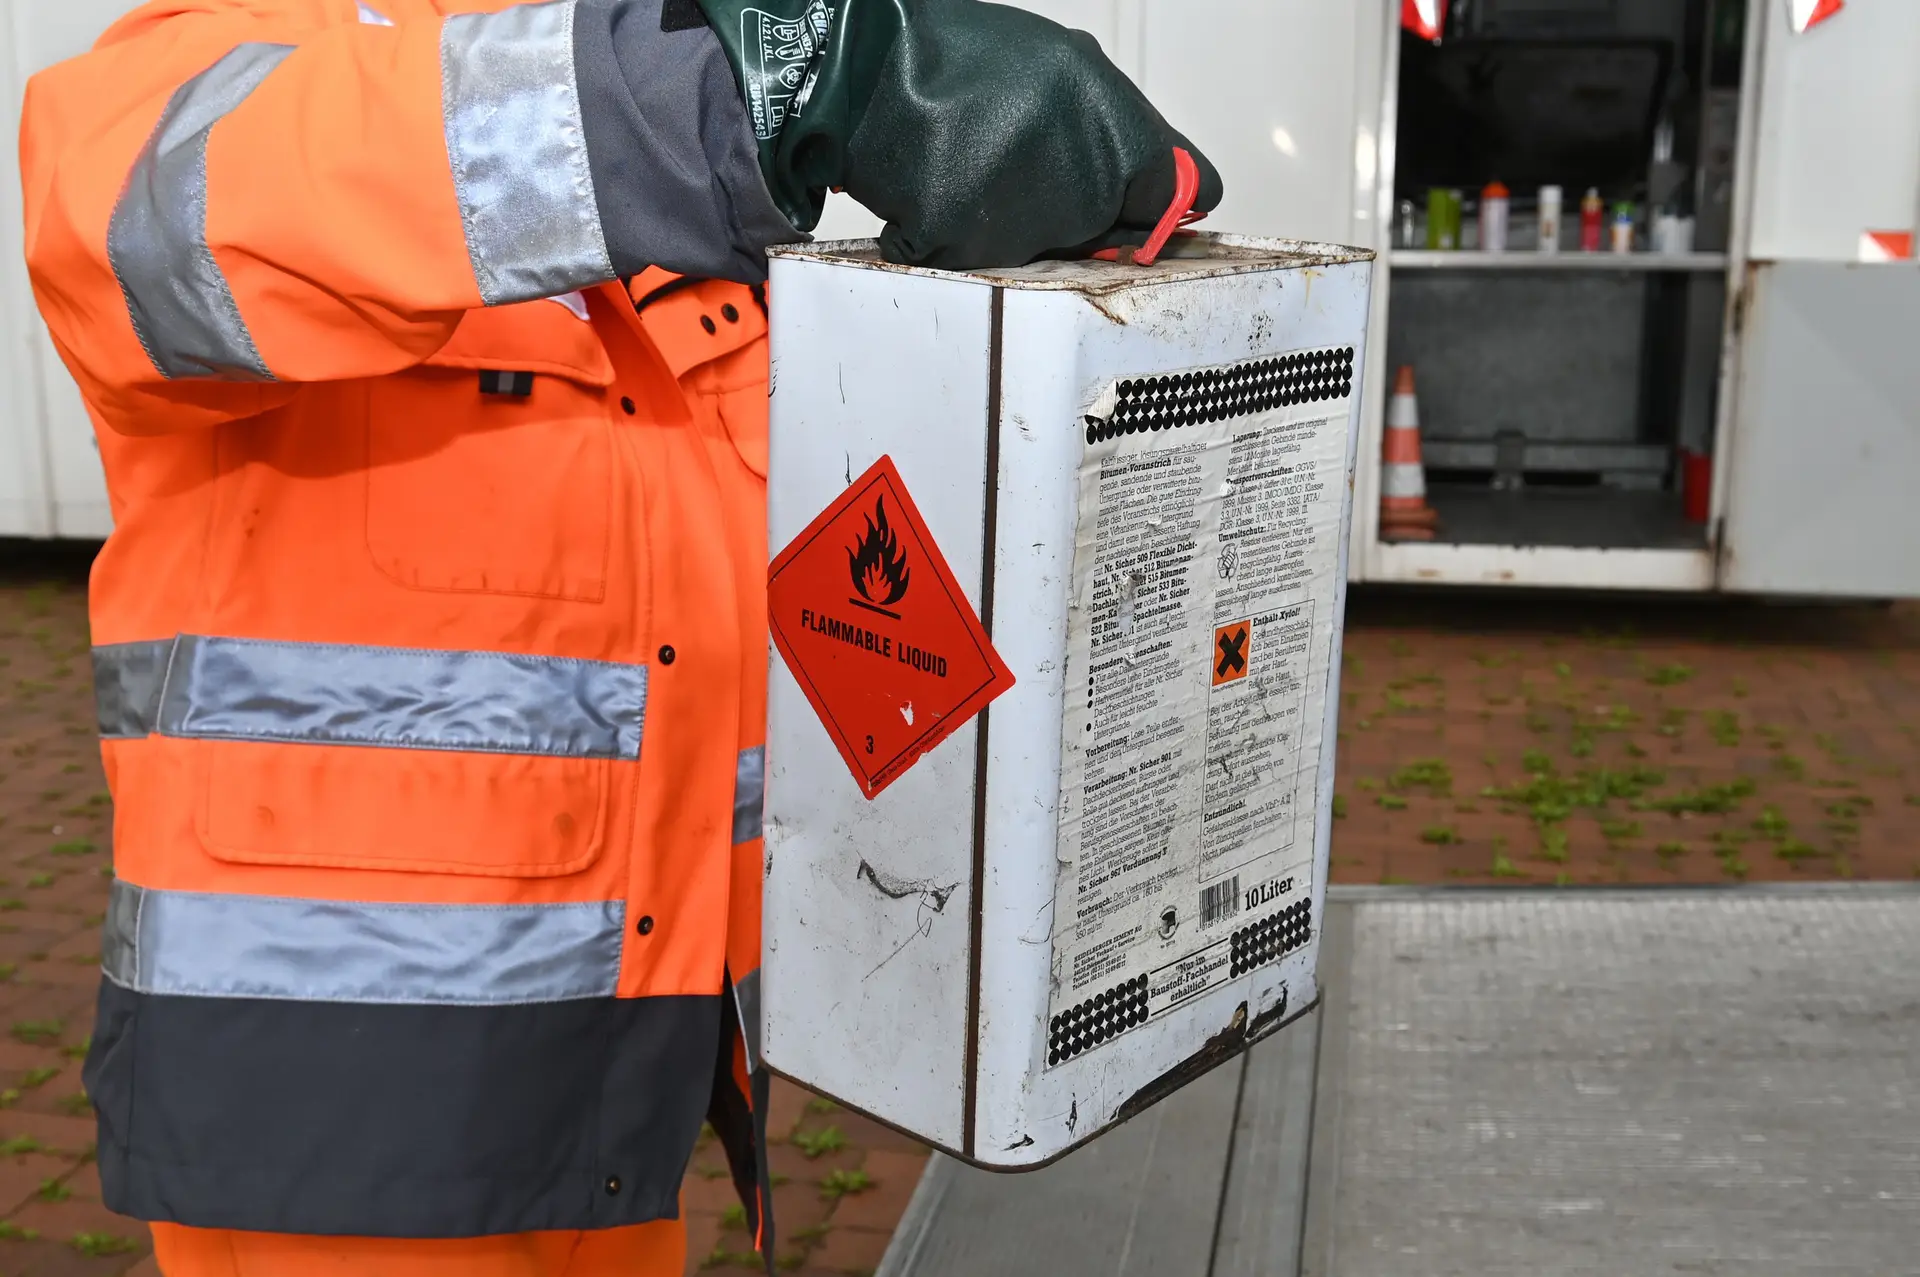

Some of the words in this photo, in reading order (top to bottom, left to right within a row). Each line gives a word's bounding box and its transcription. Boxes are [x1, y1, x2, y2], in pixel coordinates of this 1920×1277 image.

[1099, 457, 1171, 480] Bitumen-Voranstrich
[1153, 470, 1166, 481] und
[1136, 485, 1151, 495] oder
[1146, 495, 1157, 505] Die
[1158, 491, 1173, 504] gute
[1110, 515, 1122, 524] des
[1218, 525, 1266, 543] Umweltschutz:
[1103, 563, 1113, 573] Nr.
[1114, 557, 1136, 570] Sicher
[1136, 552, 1148, 564] 509
[1149, 546, 1175, 560] Flexible
[1176, 539, 1197, 553] Dicht-
[1092, 575, 1110, 588] haut,
[1110, 573, 1120, 583] Nr.
[1143, 561, 1155, 573] 512
[1092, 585, 1113, 600] strich,
[1147, 571, 1159, 583] 515
[1159, 565, 1189, 580] Bitumen-
[1137, 585, 1157, 598] Sicher
[1158, 579, 1170, 591] 533
[1170, 576, 1187, 587] Bitu-
[1143, 597, 1157, 608] oder
[1158, 593, 1168, 603] Nr.
[1169, 587, 1190, 599] Sicher
[1252, 612, 1278, 627] Enthält
[1278, 606, 1300, 620] Xylol!
[1090, 623, 1102, 636] 522
[1090, 637, 1100, 647] Nr.
[1101, 630, 1123, 644] Sicher
[1143, 617, 1158, 630] auch
[801, 608, 891, 658] FLAMMABLE
[898, 642, 948, 678] LIQUID
[1088, 656, 1124, 674] Besondere
[1164, 668, 1184, 681] Sicher
[1095, 672, 1106, 683] Für
[1093, 714, 1110, 729] Auch
[1109, 713, 1118, 723] für
[865, 735, 874, 754] 3
[1084, 735, 1129, 759] Vorbereitung:
[1130, 729, 1144, 741] Lose
[1144, 722, 1160, 735] Teile
[1082, 771, 1127, 795] Verarbeitung:
[1128, 766, 1137, 777] Nr.
[1139, 757, 1160, 772] Sicher
[1160, 751, 1171, 764] 901
[1157, 763, 1172, 775] oder
[1077, 884, 1087, 894] Nr.
[1088, 874, 1109, 889] Sicher
[1110, 867, 1121, 879] 967
[1122, 850, 1161, 874] Verdünnung
[1243, 886, 1259, 912] 10
[1258, 874, 1294, 905] Liter
[1076, 895, 1112, 919] Verbrauch:
[1112, 891, 1124, 902] Der
[1195, 954, 1206, 966] im
[1149, 953, 1229, 999] Baustoff-Fachhandel
